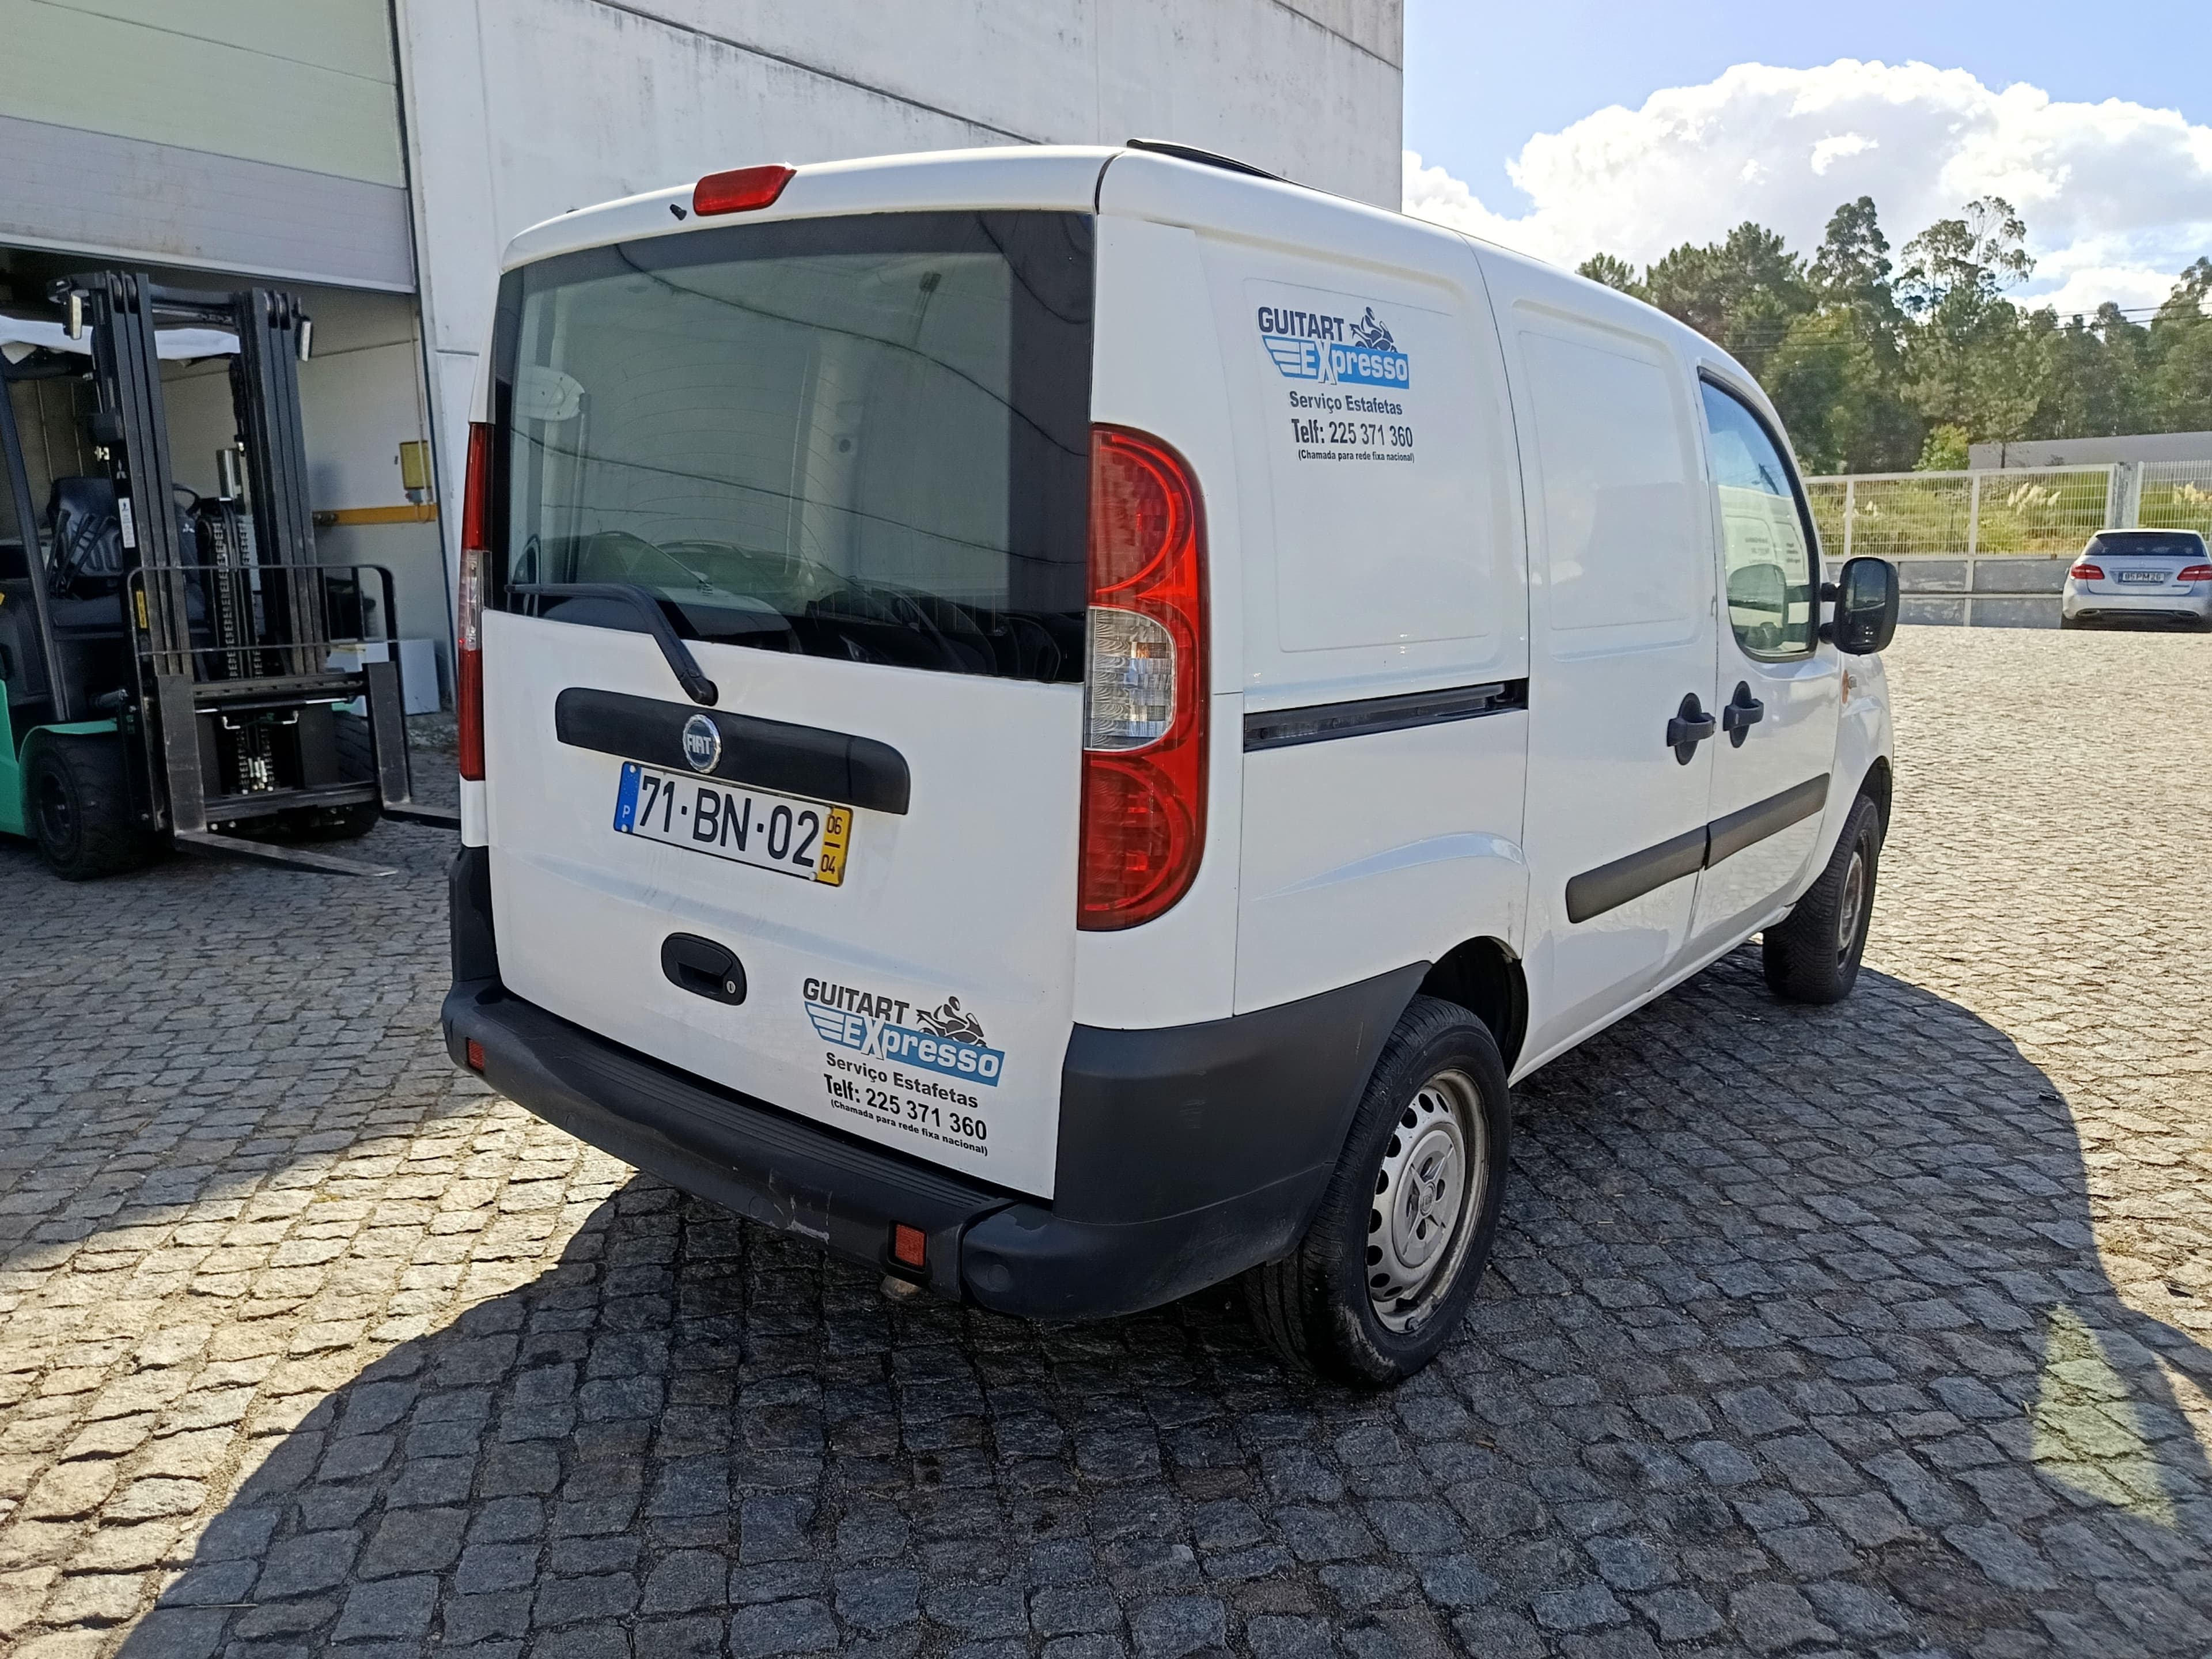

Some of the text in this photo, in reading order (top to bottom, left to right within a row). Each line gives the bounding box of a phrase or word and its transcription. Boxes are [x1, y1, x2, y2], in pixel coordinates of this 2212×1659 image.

[1257, 306, 1344, 342] GUITART
[1289, 391, 1403, 415] Serviço Estafetas
[1291, 418, 1413, 447] Telf: 225 371 360
[1298, 449, 1414, 463] (Chamada para rede fixa nacional)
[687, 734, 712, 755] FIAT
[622, 805, 631, 818] P
[827, 816, 843, 835] 06
[821, 854, 836, 875] 04
[803, 978, 910, 1024] GUITART
[826, 1052, 978, 1108] Serviço Estafetas
[824, 1073, 987, 1141] Telf: 225 371 360
[831, 1099, 988, 1157] (Chamada para rede fixa nacional)
